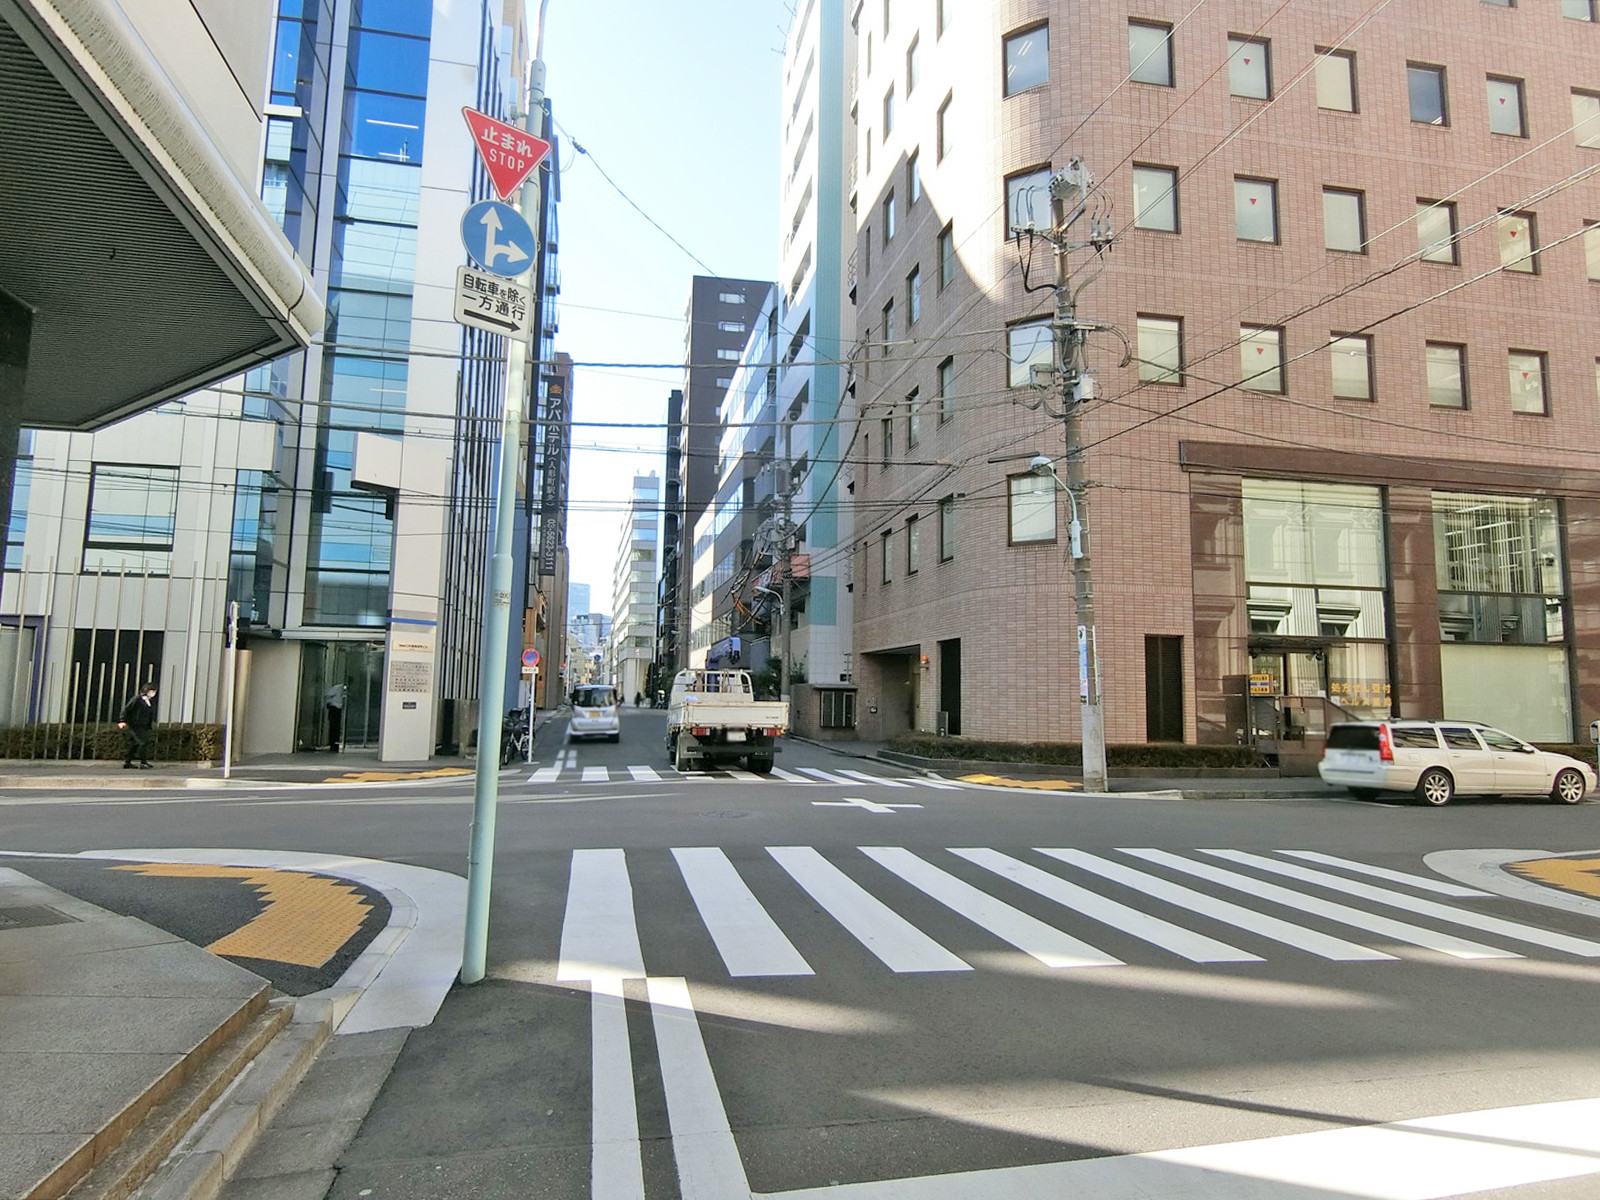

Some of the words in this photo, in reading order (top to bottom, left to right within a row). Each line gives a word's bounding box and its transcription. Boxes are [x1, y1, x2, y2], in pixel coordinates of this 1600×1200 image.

[481, 126, 534, 158] 止まれ
[489, 148, 525, 173] STOP
[463, 273, 525, 307] 自転車を除く
[461, 294, 526, 322] 一方通行
